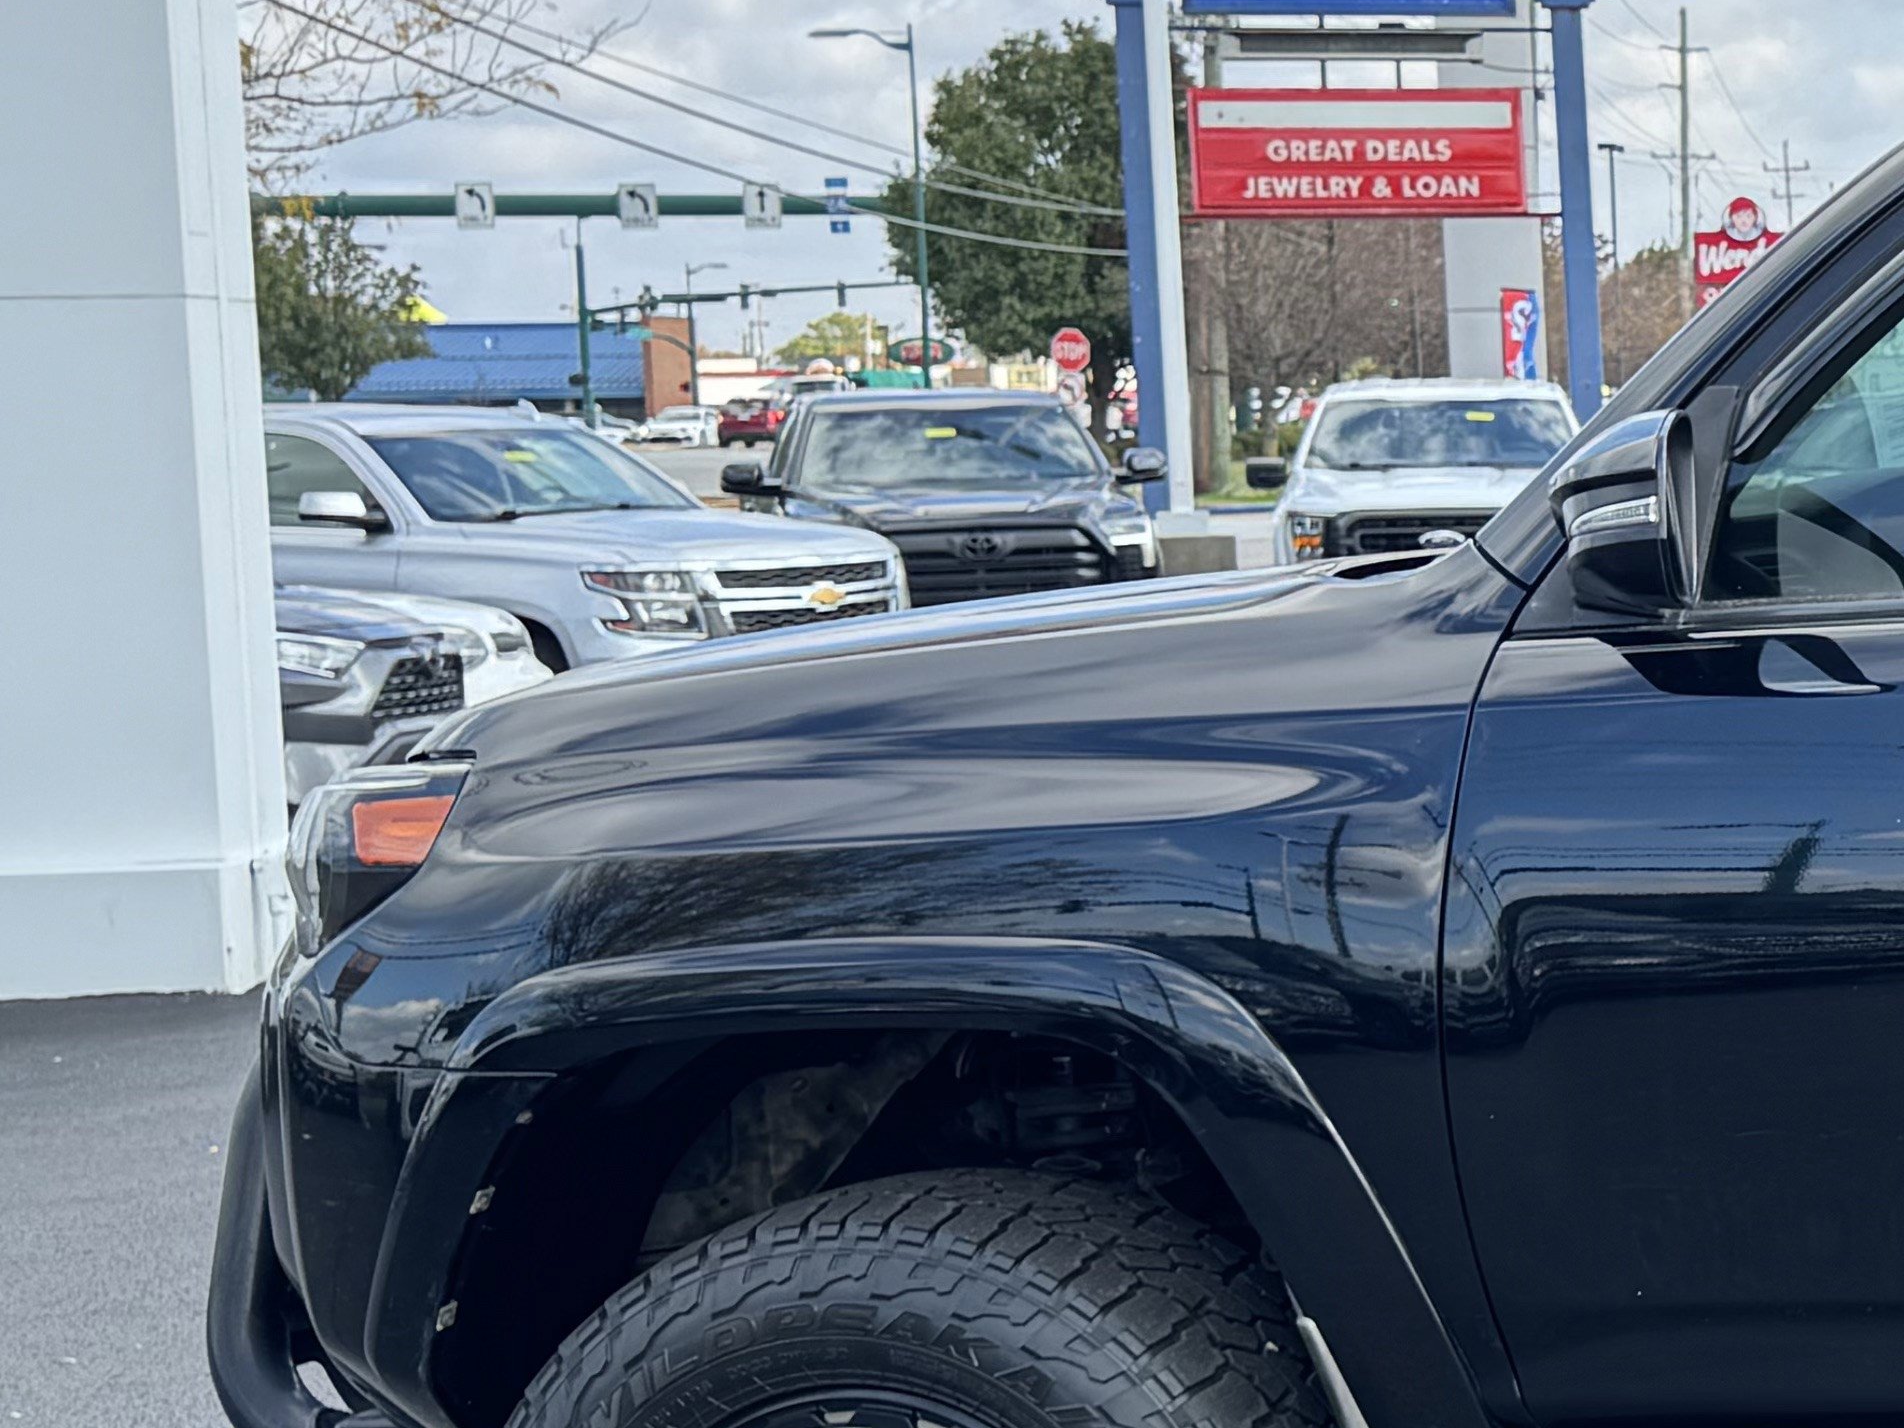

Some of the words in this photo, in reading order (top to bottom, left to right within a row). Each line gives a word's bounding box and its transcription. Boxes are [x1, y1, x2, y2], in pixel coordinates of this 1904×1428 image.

[1266, 139, 1355, 163] GREAT
[1365, 139, 1453, 163] DEALS
[1242, 177, 1364, 199] JEWELRY
[1371, 177, 1393, 198] &
[1402, 177, 1481, 198] LOAN
[1699, 238, 1768, 277] Wend
[1056, 341, 1088, 360] STOP
